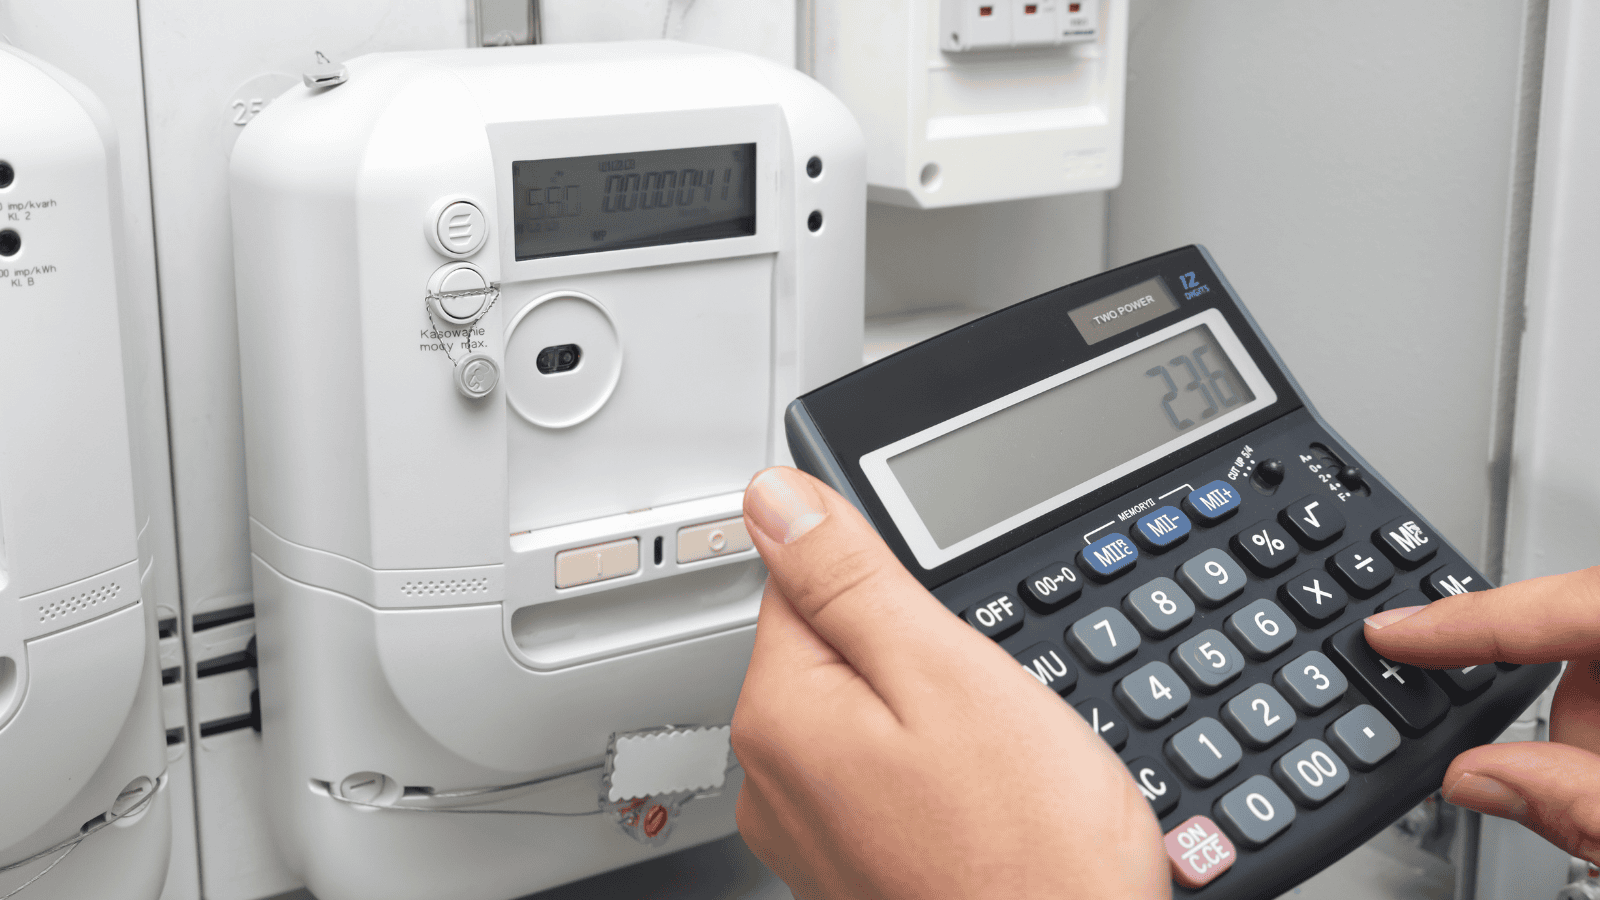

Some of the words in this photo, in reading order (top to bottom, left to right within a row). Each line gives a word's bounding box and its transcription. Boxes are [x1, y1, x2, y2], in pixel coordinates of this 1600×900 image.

[8, 199, 57, 211] imp/kvarh
[25, 211, 31, 220] 2
[14, 265, 57, 276] imp/kWh
[27, 277, 35, 286] B
[1093, 310, 1118, 325] TWO
[1117, 295, 1155, 316] POWER
[420, 327, 486, 339] Kasowanie
[1145, 344, 1243, 431] 236
[1227, 465, 1240, 481] CUT
[1234, 456, 1246, 468] UP
[1240, 444, 1254, 459] 5/4
[1252, 529, 1285, 555] %
[1204, 561, 1229, 585] 9
[975, 596, 1014, 627] OFF
[1150, 590, 1177, 615] 8
[1093, 619, 1117, 647] 7
[1254, 611, 1280, 636] 6
[1198, 642, 1226, 668] 5
[1149, 675, 1172, 700] 4
[1303, 665, 1330, 690] 3
[1251, 698, 1281, 727] 2
[1198, 733, 1222, 759] 1
[1296, 750, 1338, 787] 00
[1246, 792, 1275, 822] 0
[1177, 822, 1207, 849] ON
[1188, 837, 1231, 874] C.CE
